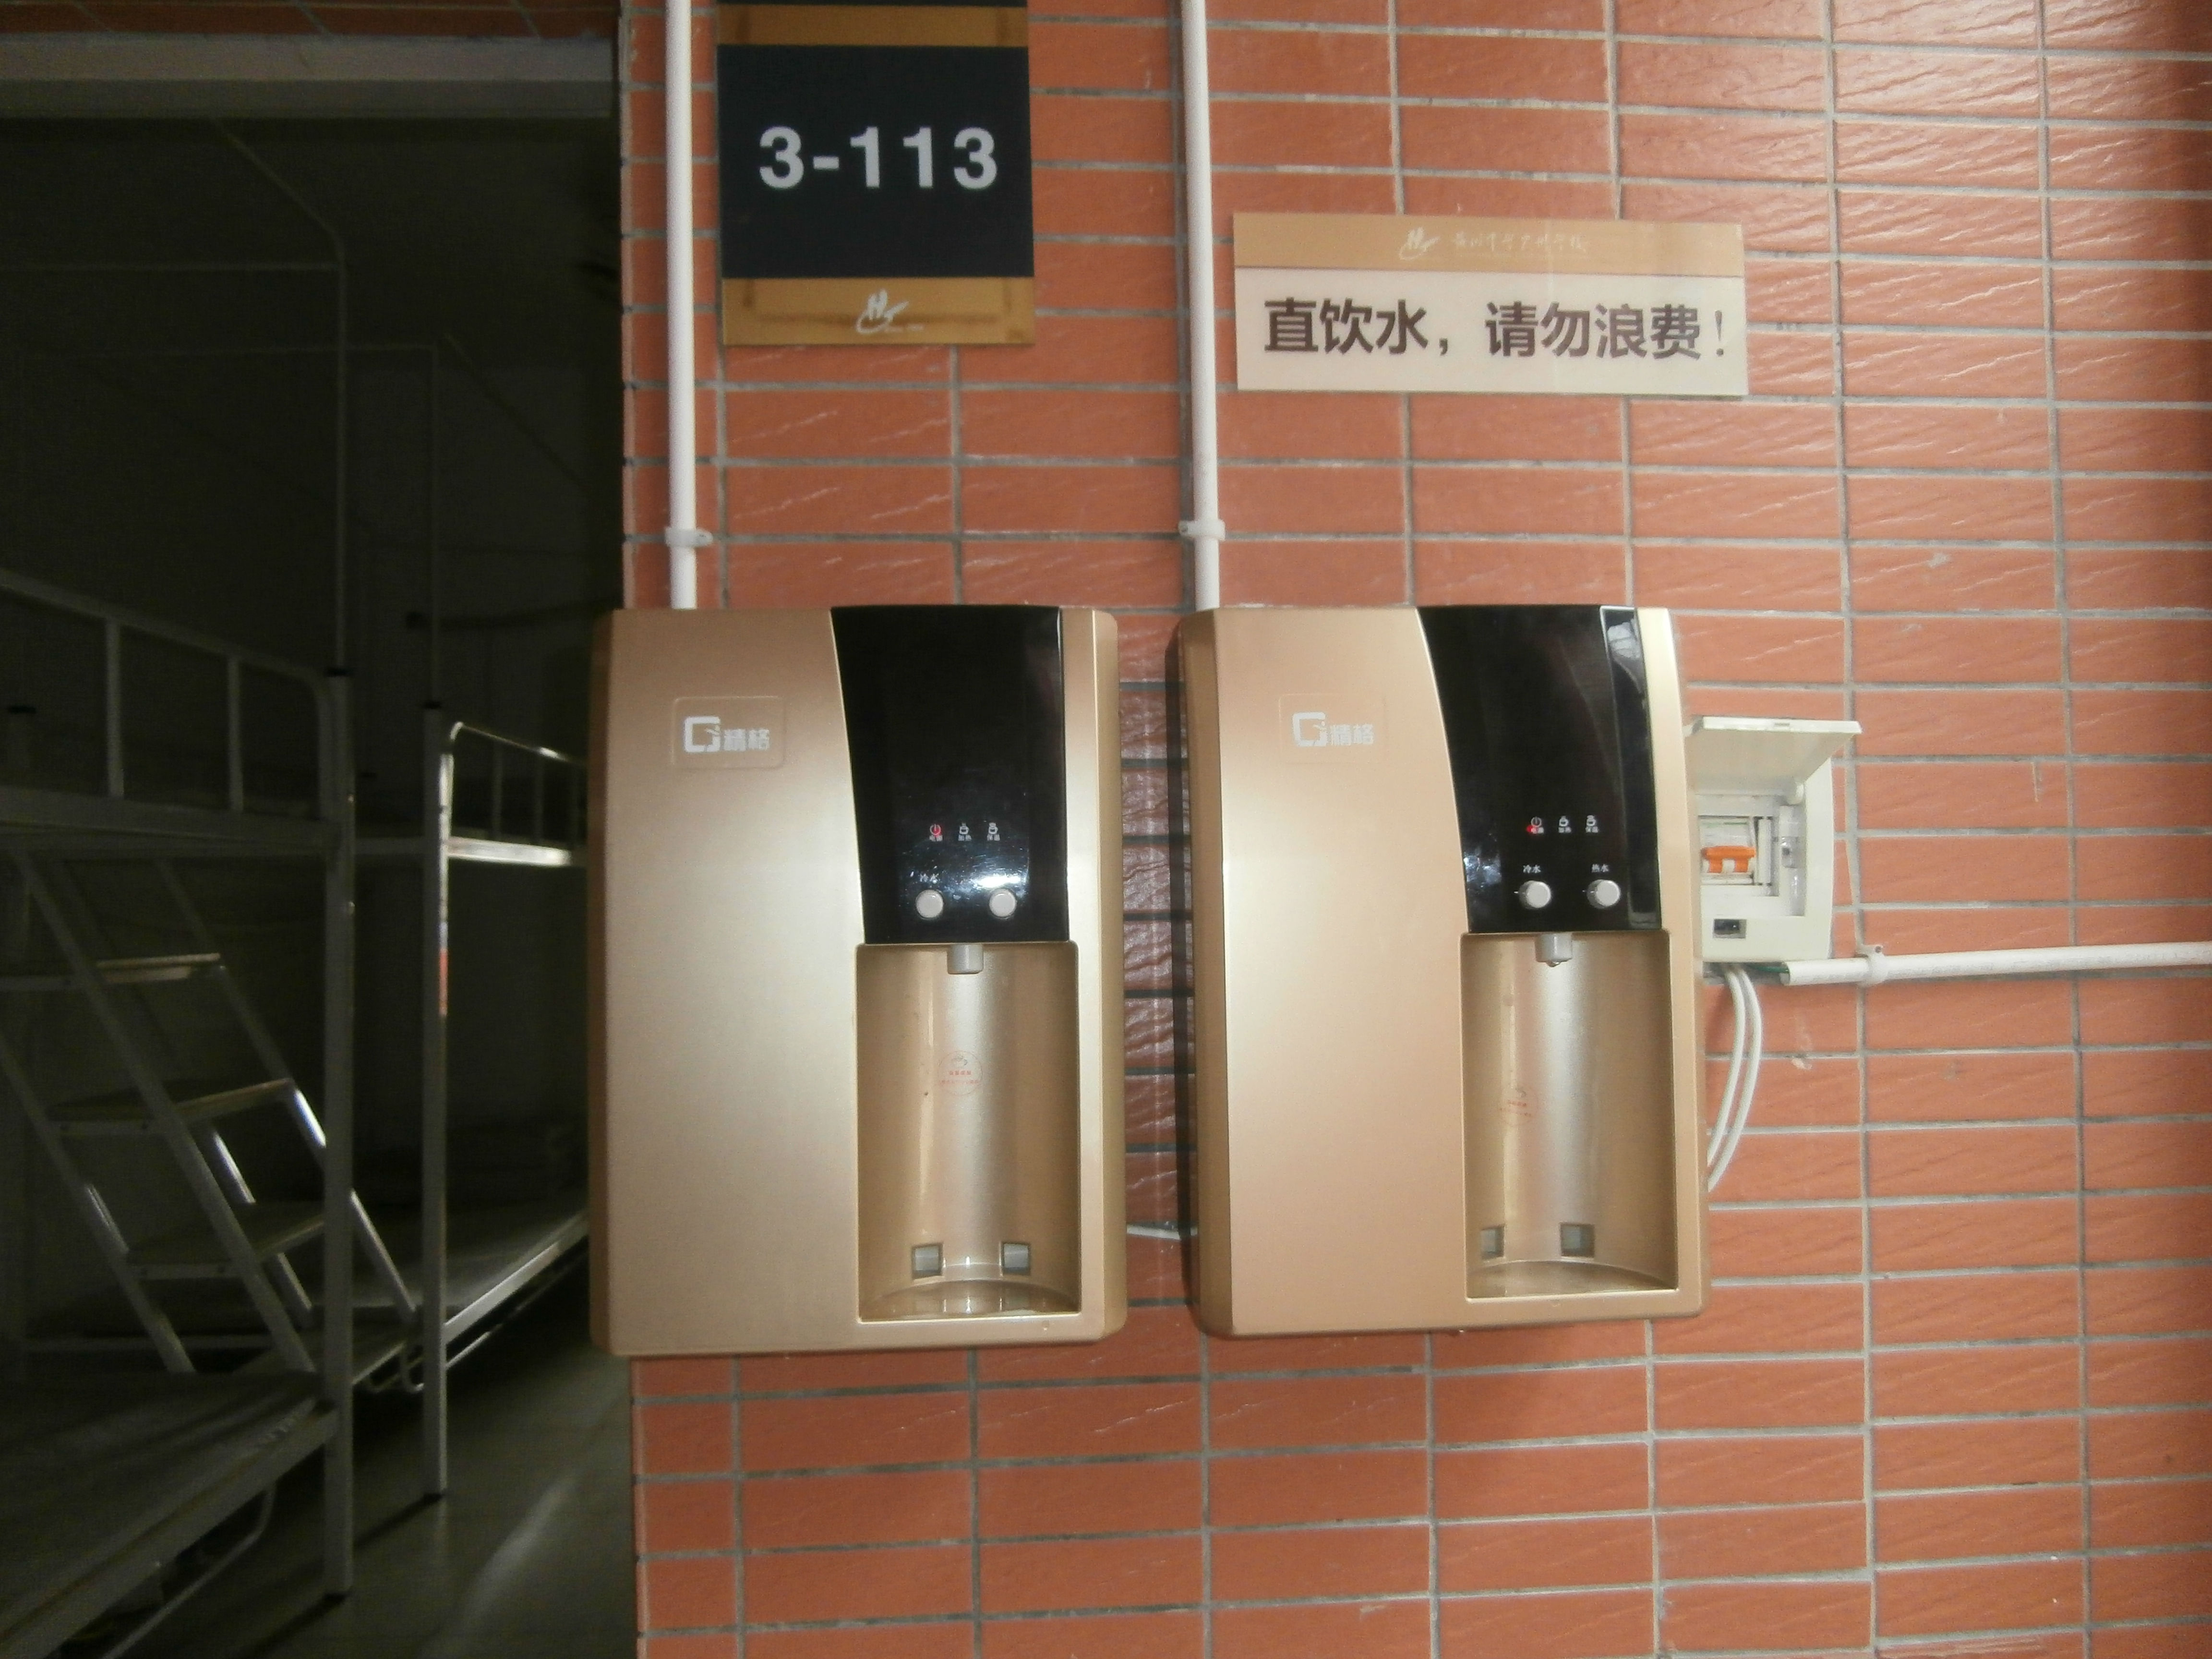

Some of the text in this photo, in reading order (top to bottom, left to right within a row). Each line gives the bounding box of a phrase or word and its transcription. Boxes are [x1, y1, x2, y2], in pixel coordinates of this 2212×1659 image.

[759, 126, 998, 190] 3-113
[1523, 865, 1541, 873] 冷水
[1591, 864, 1609, 873] 热水
